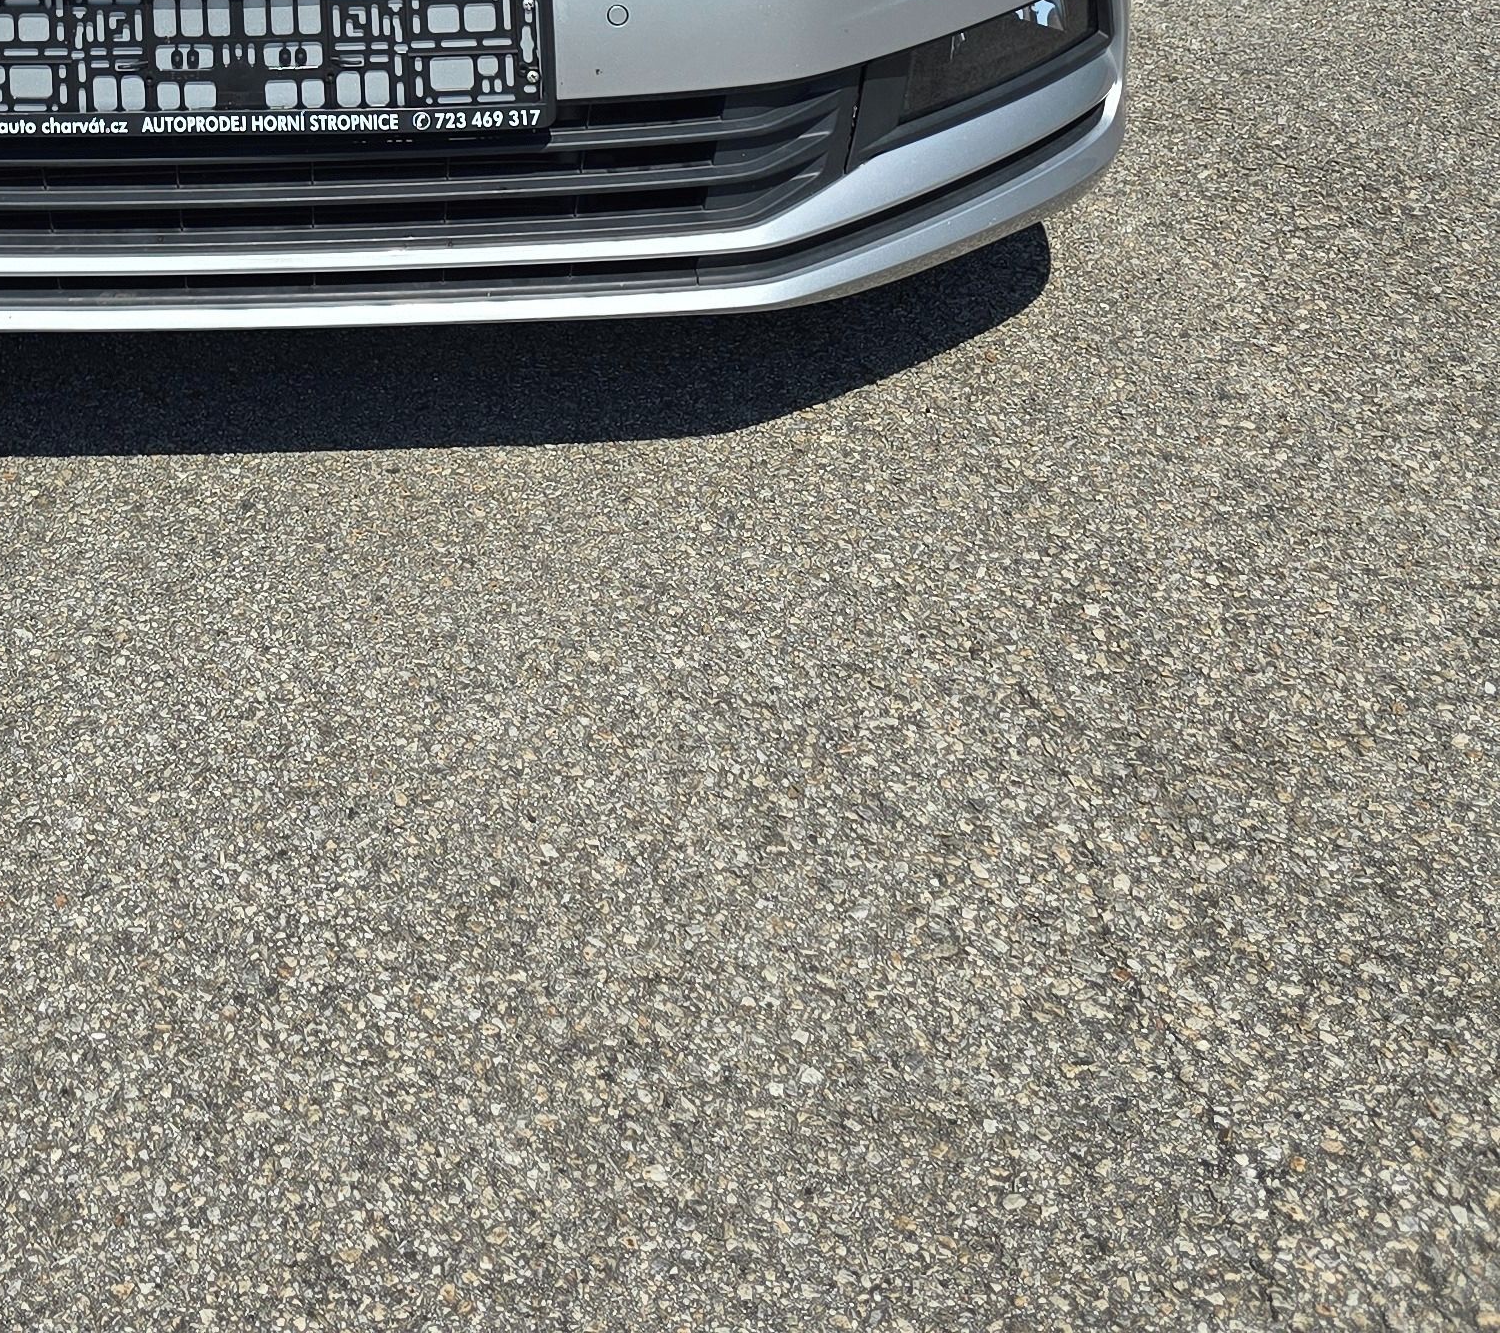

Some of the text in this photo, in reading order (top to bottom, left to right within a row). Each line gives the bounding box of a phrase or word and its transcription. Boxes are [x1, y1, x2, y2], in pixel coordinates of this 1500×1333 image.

[41, 116, 129, 135] charvát.cz
[141, 115, 248, 134] AUTOPRODEJ
[251, 110, 306, 132] HORNÍ
[309, 112, 399, 132] STROPNICE
[434, 111, 467, 129] 723
[471, 110, 504, 128] 469
[508, 108, 541, 127] 317
